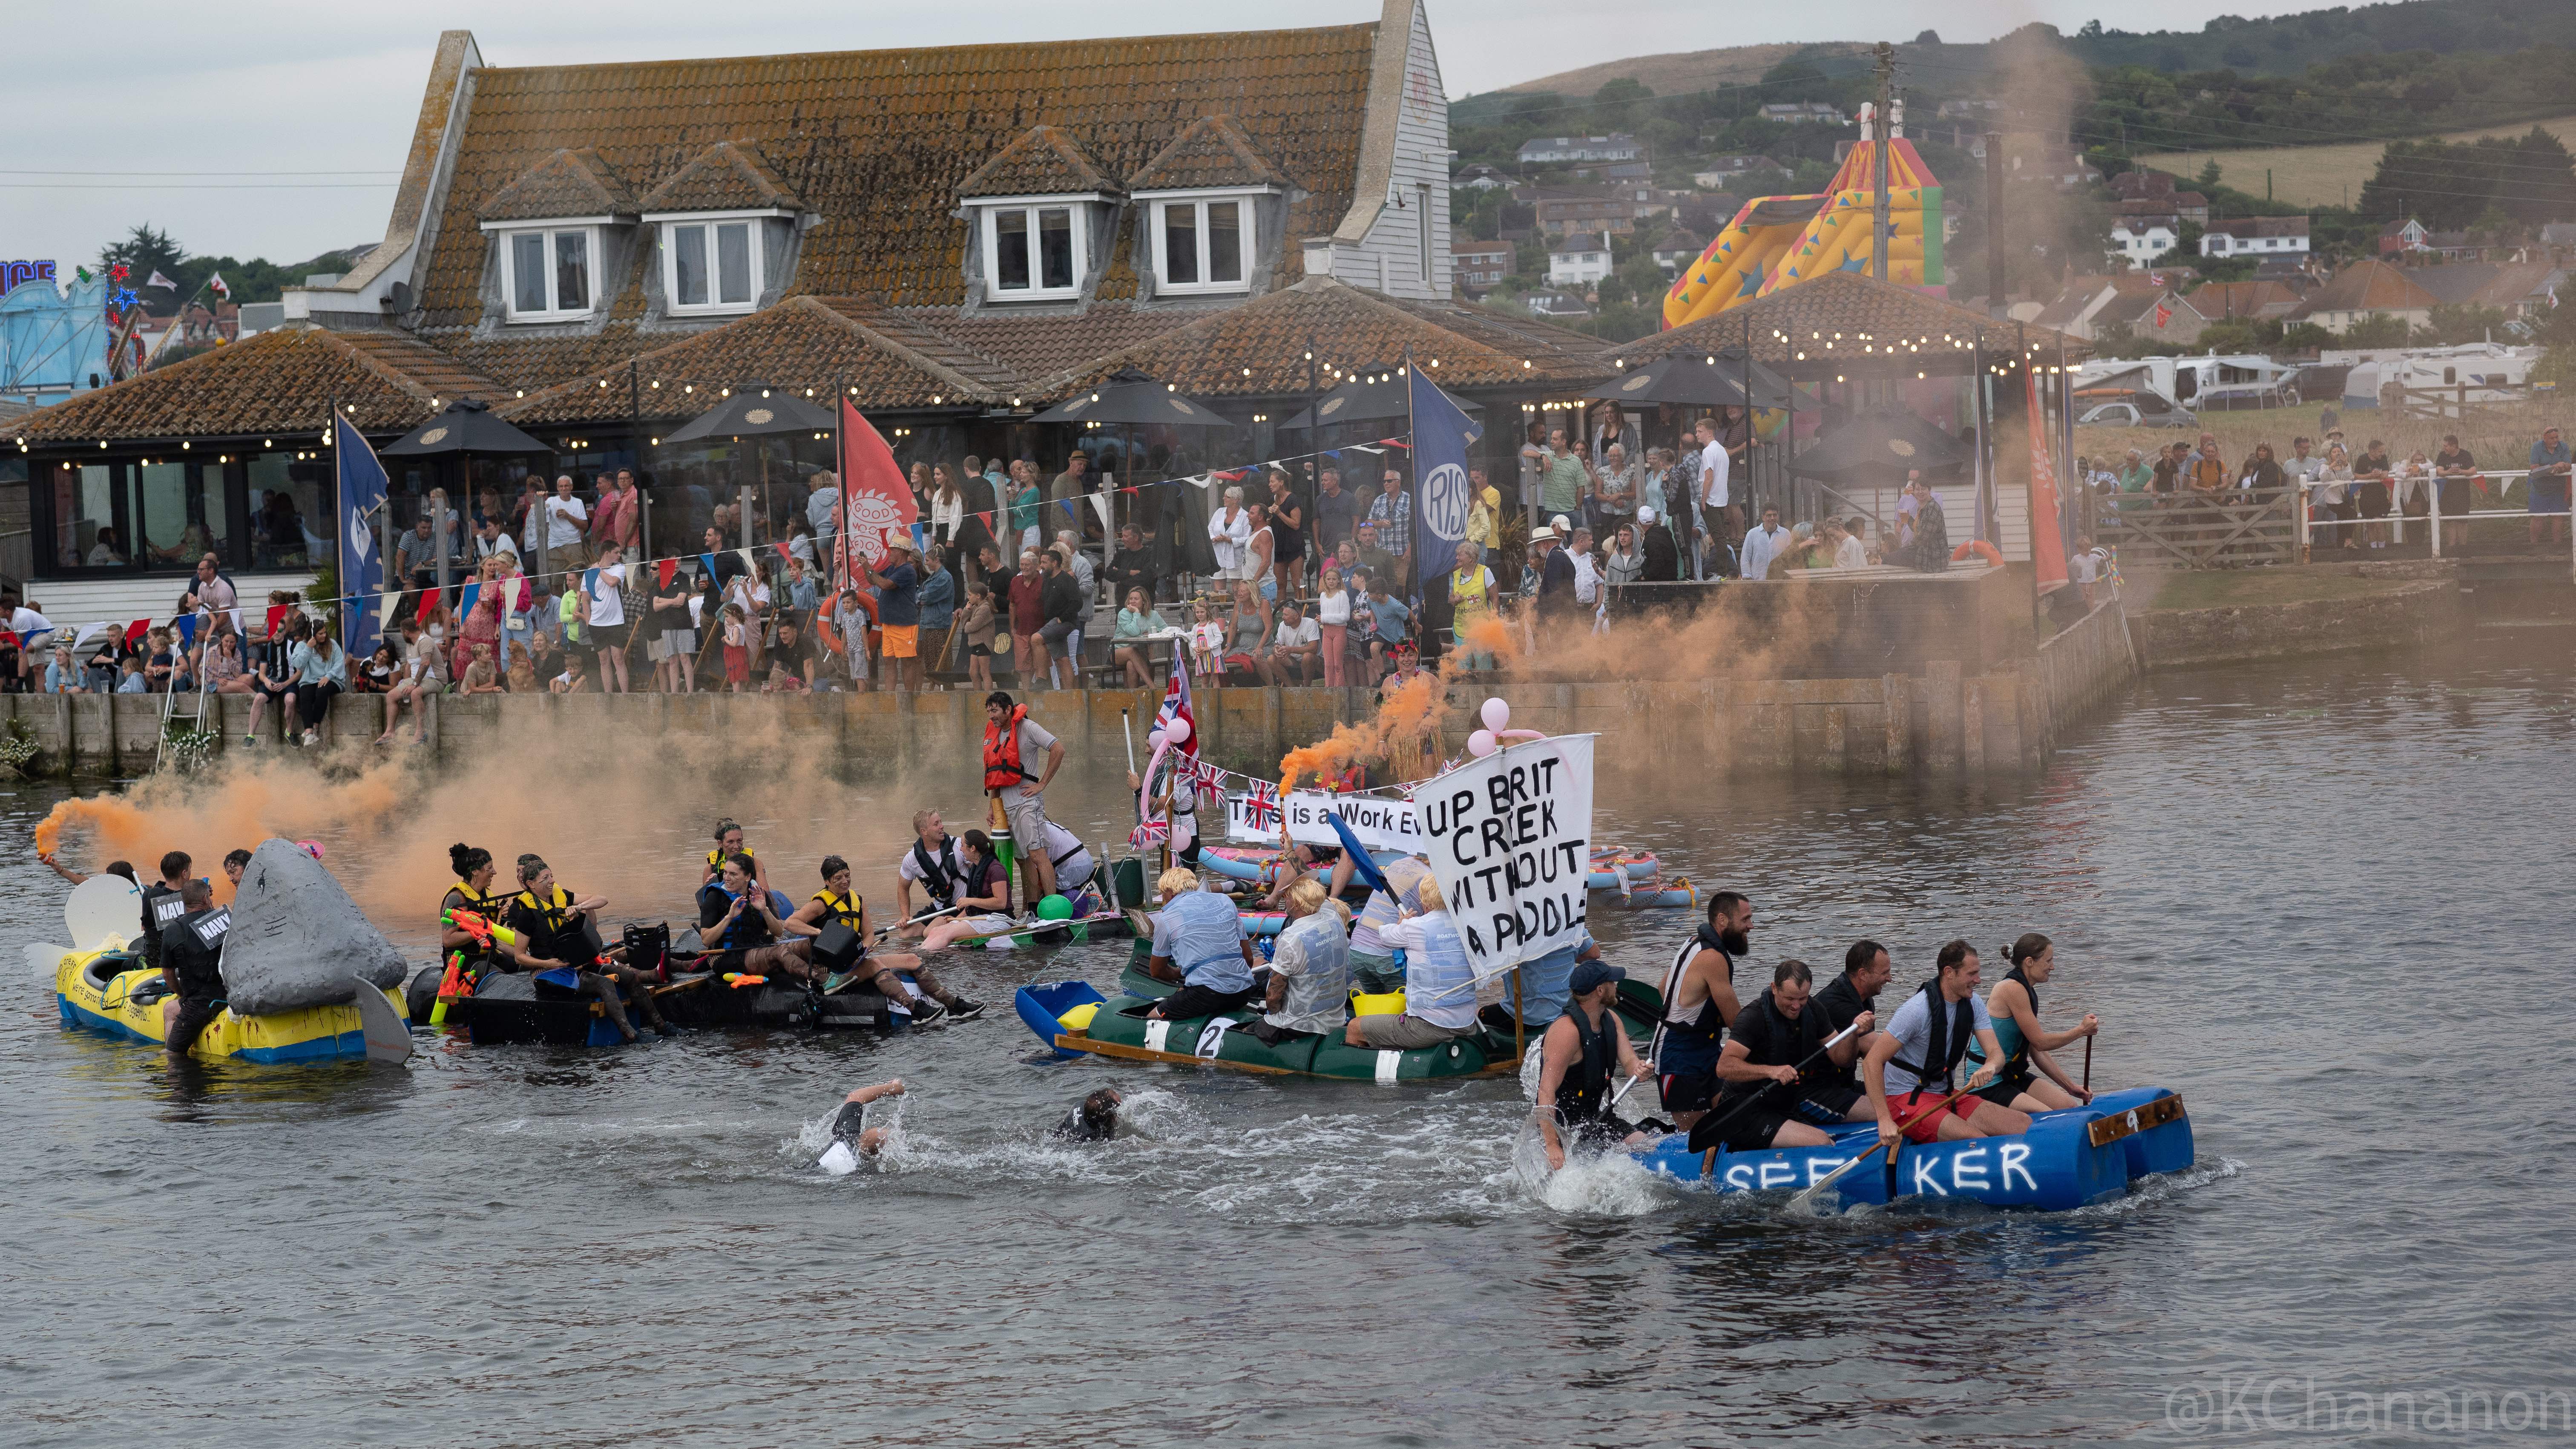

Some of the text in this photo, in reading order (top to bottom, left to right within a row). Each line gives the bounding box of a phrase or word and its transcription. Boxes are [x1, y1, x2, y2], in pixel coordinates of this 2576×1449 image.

[855, 503, 889, 519] GOOD
[1429, 469, 1467, 535] RISE
[995, 633, 1011, 653] RISE
[1426, 757, 1560, 837] UP BRIT
[1293, 802, 1310, 824] is
[1318, 808, 1329, 824] a
[1338, 803, 1393, 831] Work
[1450, 840, 1584, 916] WITHOUT
[198, 913, 231, 940] NAVY
[1315, 934, 1339, 947] BOATWORLD
[1466, 925, 1487, 957] A
[1199, 1026, 1221, 1056] 2
[2127, 1110, 2139, 1132] 9
